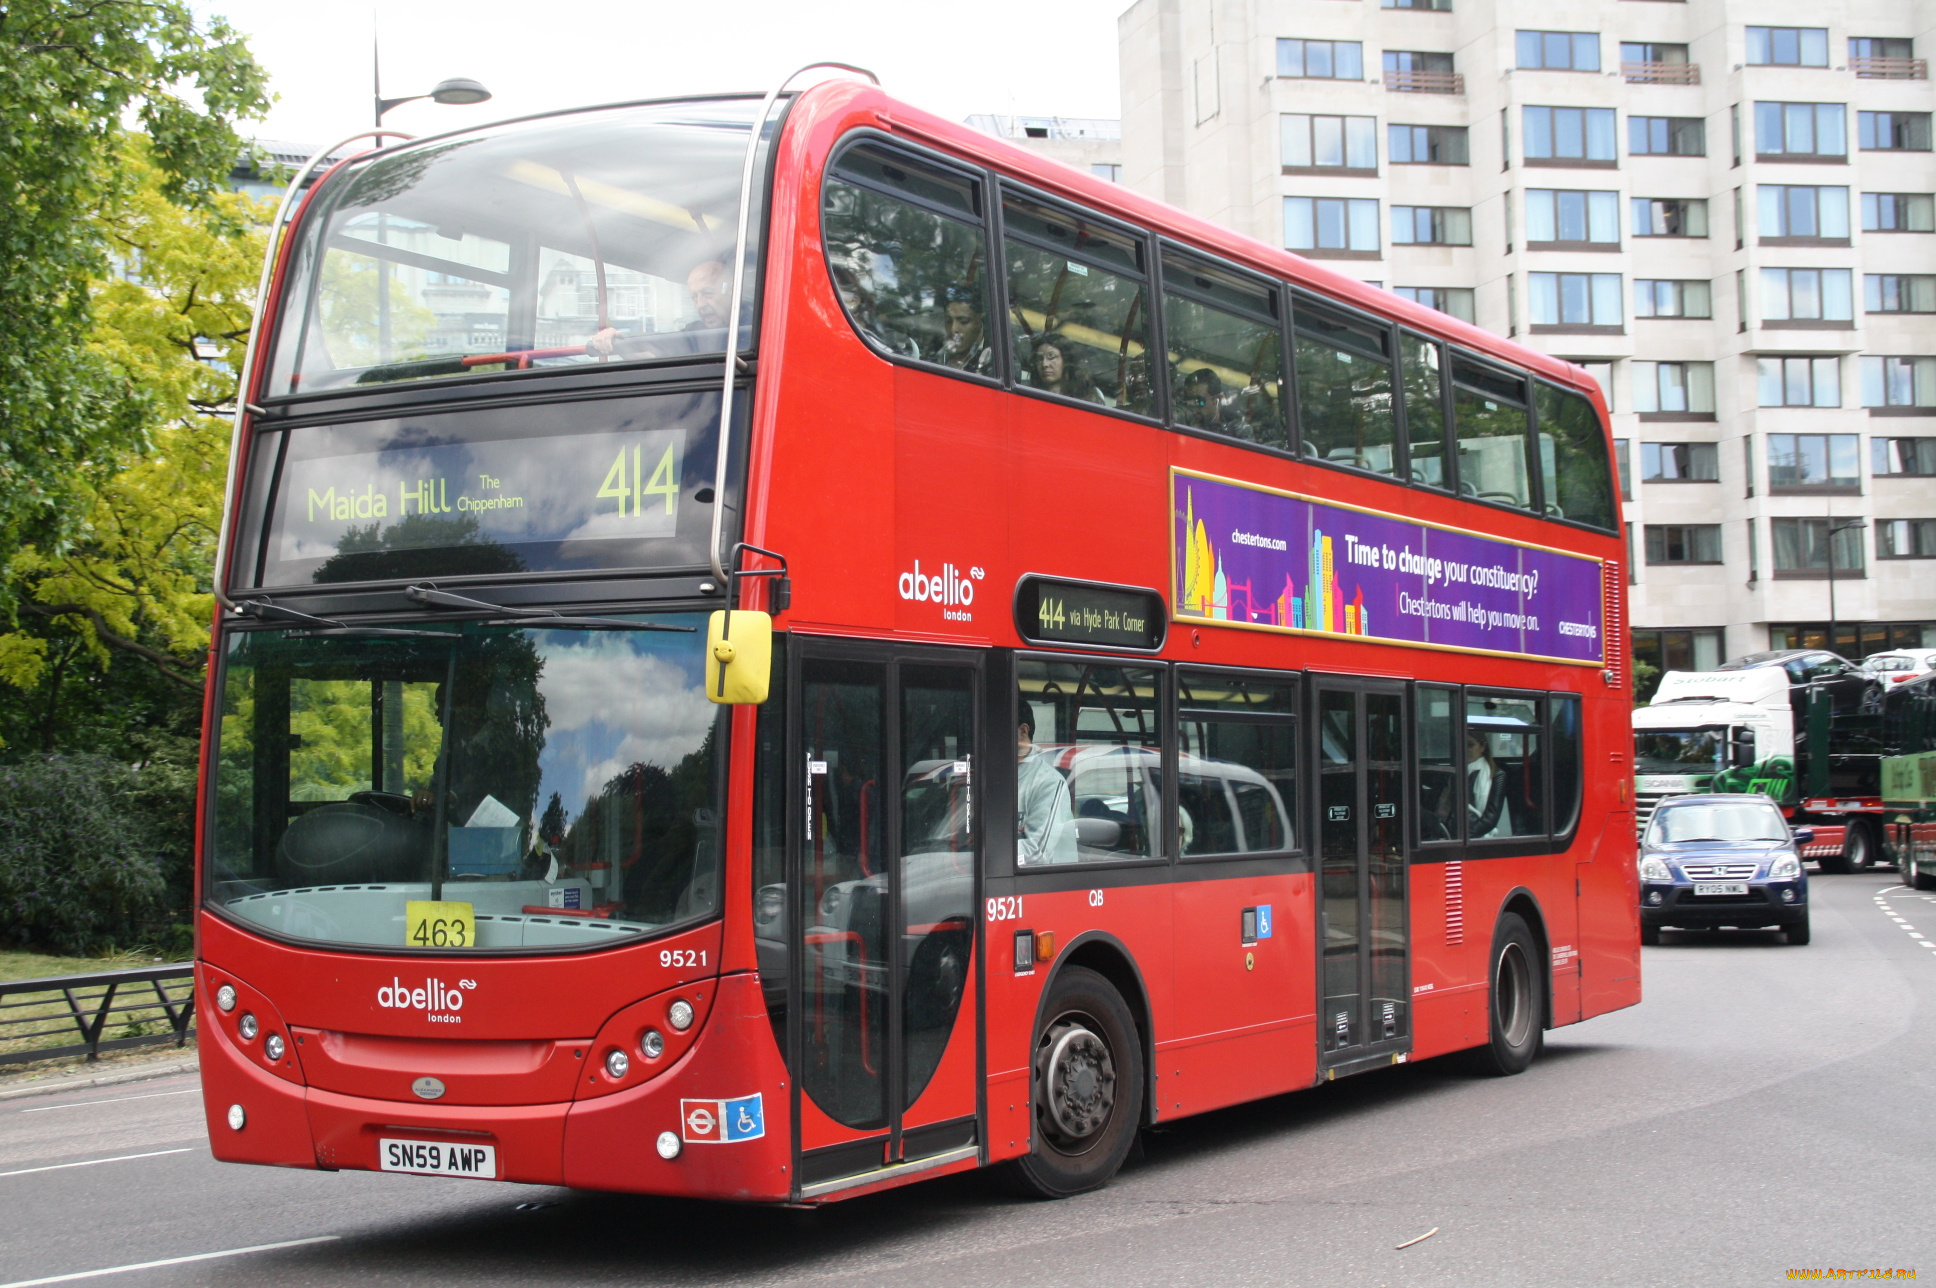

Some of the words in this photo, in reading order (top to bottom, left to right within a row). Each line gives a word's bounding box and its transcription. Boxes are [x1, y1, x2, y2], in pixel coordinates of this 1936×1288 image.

[479, 474, 500, 489] The
[596, 441, 679, 518] 414
[308, 484, 387, 522] Maida
[400, 478, 451, 515] Hill
[457, 494, 523, 515] Chippenham
[1231, 529, 1287, 551] chestertons.com
[1345, 534, 1380, 568] Time
[1382, 544, 1396, 570] to
[1399, 545, 1442, 585] change
[1443, 561, 1469, 587] your
[1470, 565, 1538, 600] constituency?
[899, 559, 974, 607] abellio
[943, 608, 972, 622] london
[1039, 597, 1066, 630] 414
[1069, 609, 1080, 626] via
[1083, 607, 1102, 633] Hyde
[1104, 609, 1120, 630] Park
[1122, 611, 1145, 633] Corner
[1399, 591, 1451, 620] Chestertons
[1452, 600, 1467, 622] will
[1467, 601, 1487, 630] help
[1487, 610, 1503, 630] you
[1503, 613, 1526, 630] move
[1526, 616, 1540, 631] on.
[1558, 620, 1597, 639] CHESTERTONS
[987, 896, 1023, 922] 9521
[1088, 889, 1104, 907] QB
[413, 918, 466, 947] 463
[659, 949, 708, 968] 9521
[377, 976, 463, 1011] abellio
[427, 1012, 461, 1023] london
[388, 1143, 441, 1169] SN59
[447, 1147, 486, 1172] AWP
